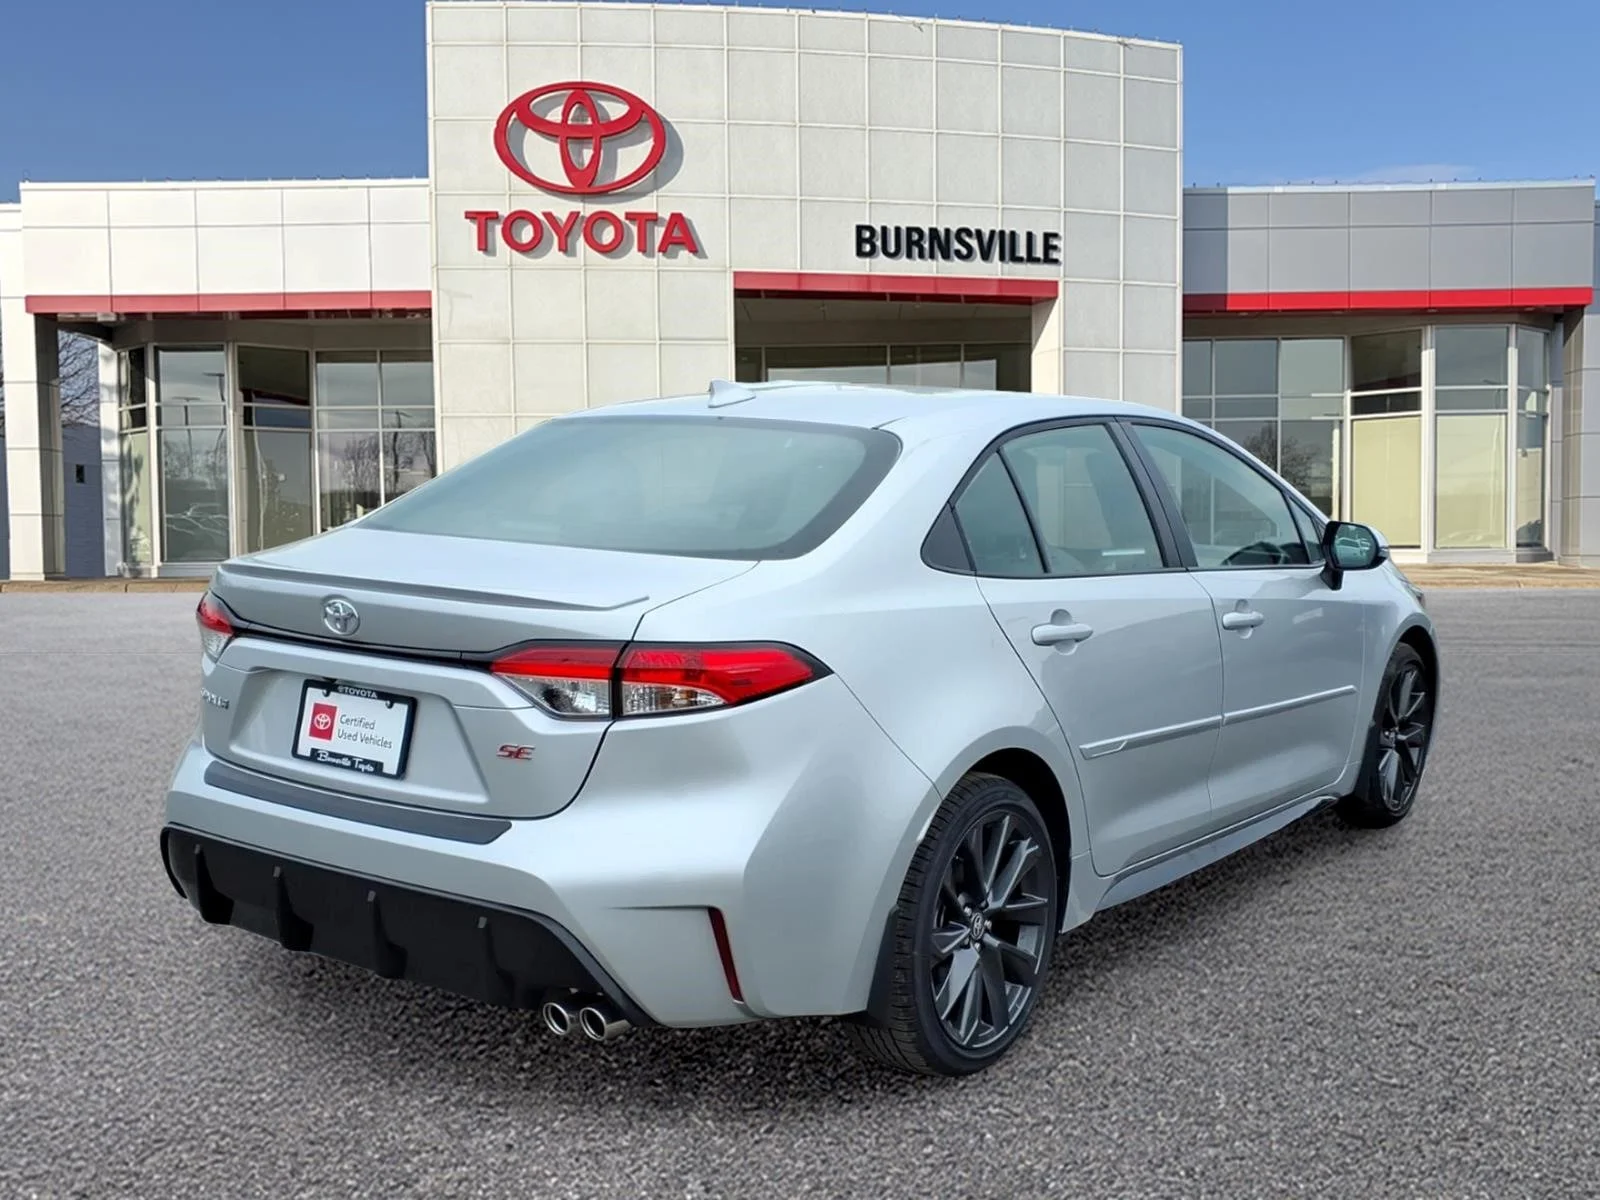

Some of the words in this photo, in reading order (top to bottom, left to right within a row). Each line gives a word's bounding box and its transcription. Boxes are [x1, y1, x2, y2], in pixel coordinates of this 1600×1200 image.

[464, 210, 699, 254] TOYOTA
[855, 224, 1061, 264] BURNSVILLE
[344, 686, 378, 699] TOYOTA
[339, 714, 376, 731] Certified
[337, 729, 358, 742] Used
[360, 732, 392, 749] Vehicles
[496, 743, 536, 760] SE
